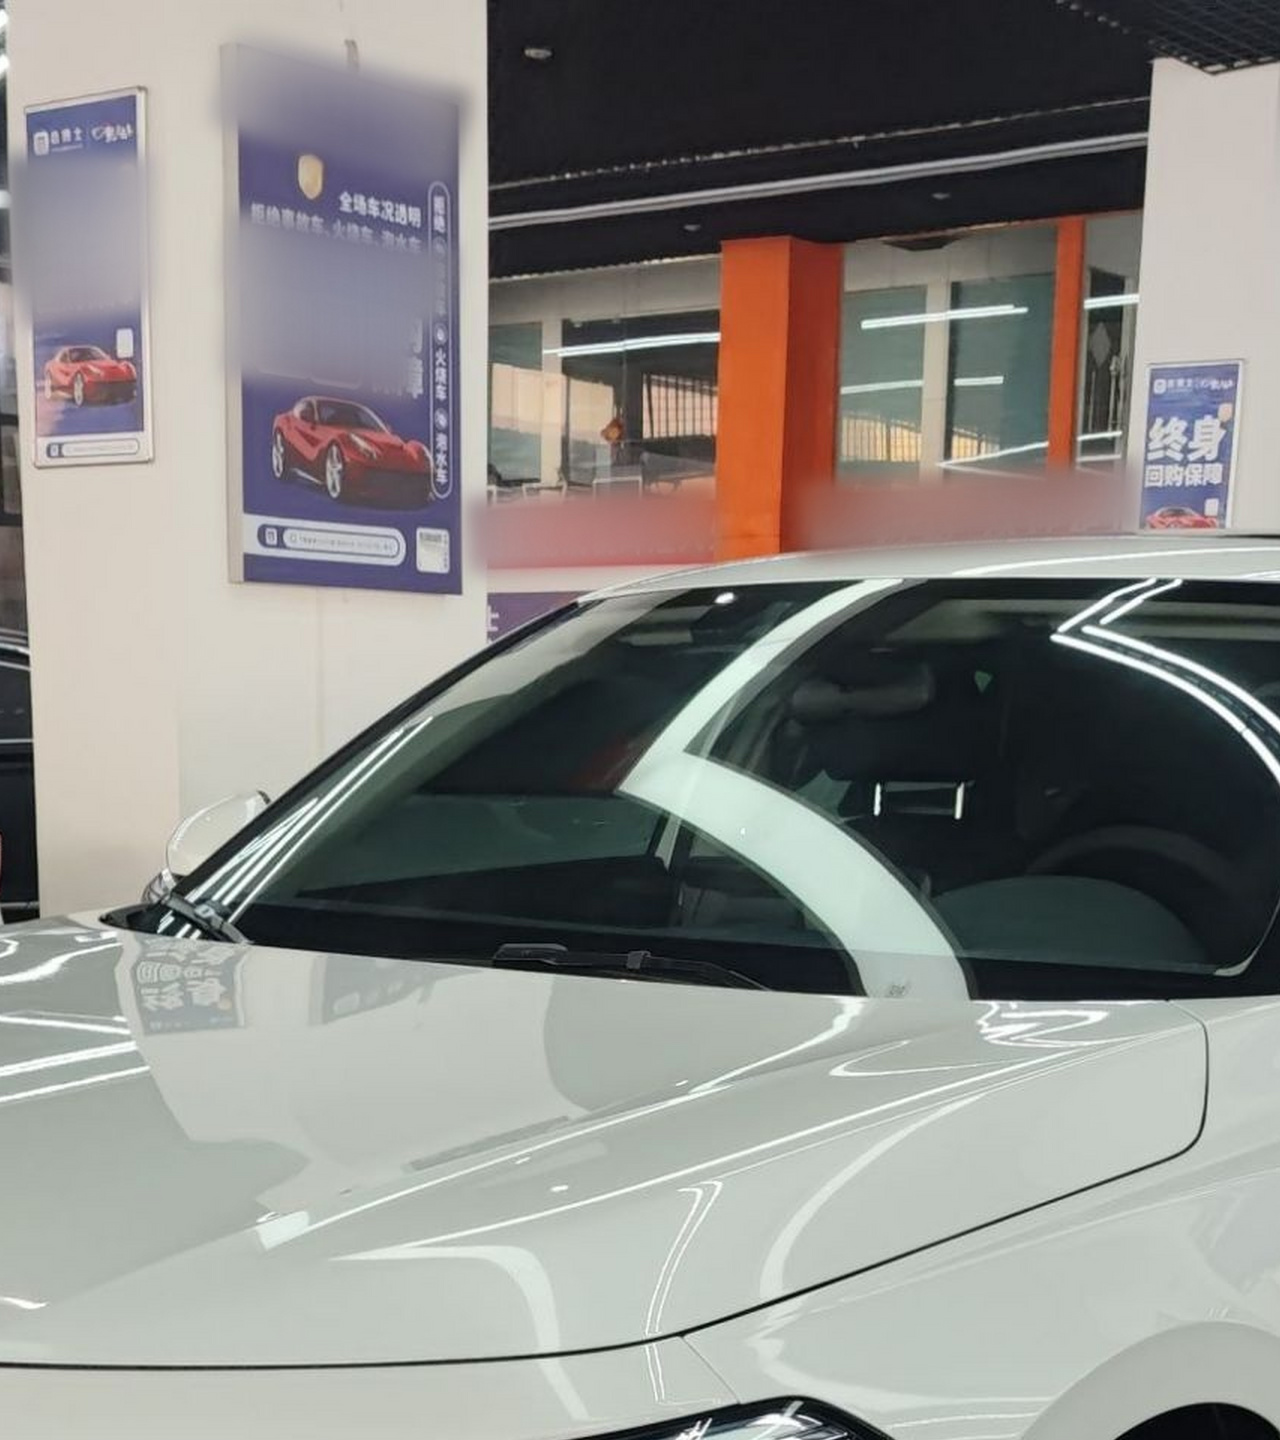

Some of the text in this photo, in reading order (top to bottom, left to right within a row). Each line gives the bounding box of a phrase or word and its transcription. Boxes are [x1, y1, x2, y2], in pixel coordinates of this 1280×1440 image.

[338, 191, 422, 229] 全场车况透明
[1147, 414, 1227, 462] 终身
[1145, 463, 1224, 488] 回购保障
